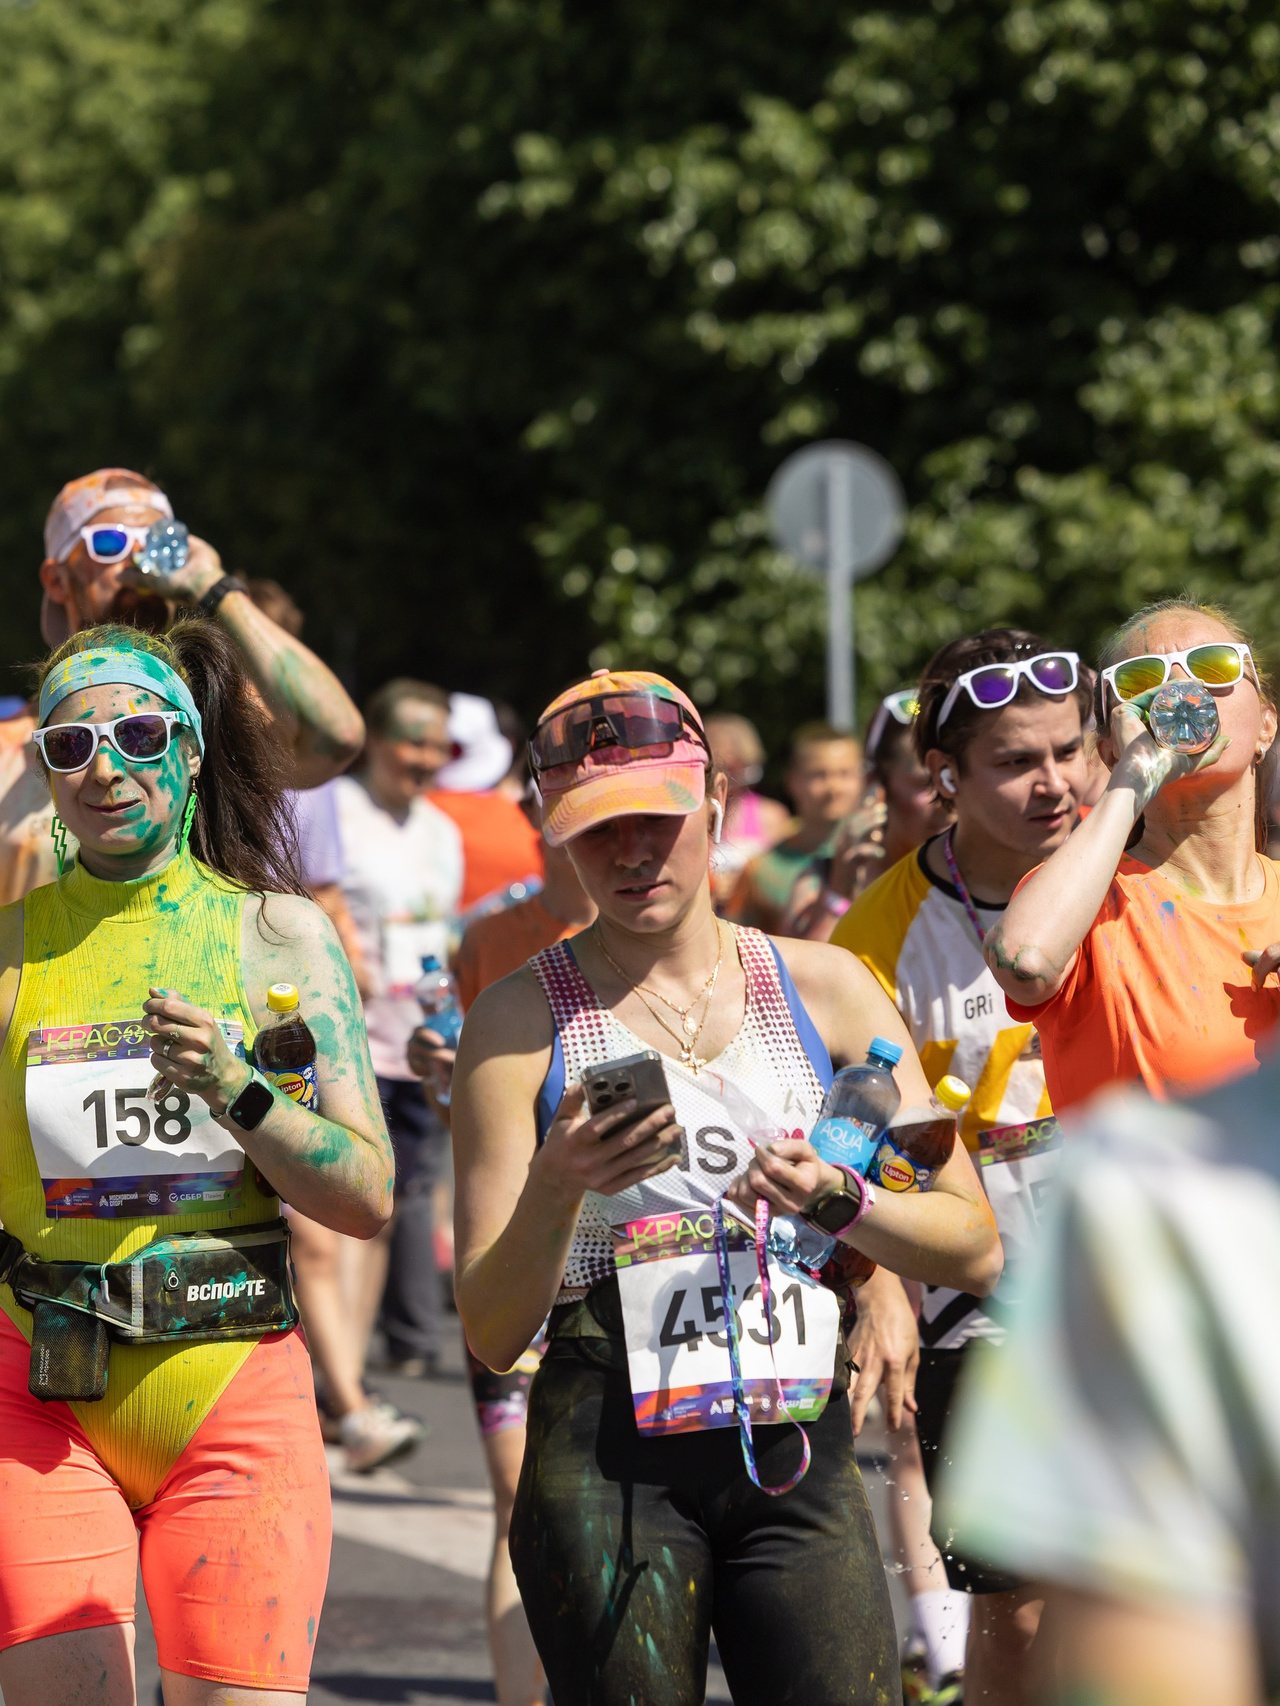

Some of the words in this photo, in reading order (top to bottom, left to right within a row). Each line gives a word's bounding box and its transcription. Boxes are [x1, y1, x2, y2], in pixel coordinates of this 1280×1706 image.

[46, 1048, 138, 1062] ЗАБЕГ
[277, 1082, 302, 1094] ipton
[83, 1087, 192, 1148] 158
[820, 1121, 863, 1152] AQUA
[884, 1165, 910, 1183] Lipton
[180, 1193, 202, 1201] СБЕР
[187, 1278, 266, 1302] ВСПОРТЕ
[659, 1283, 806, 1352] 4531
